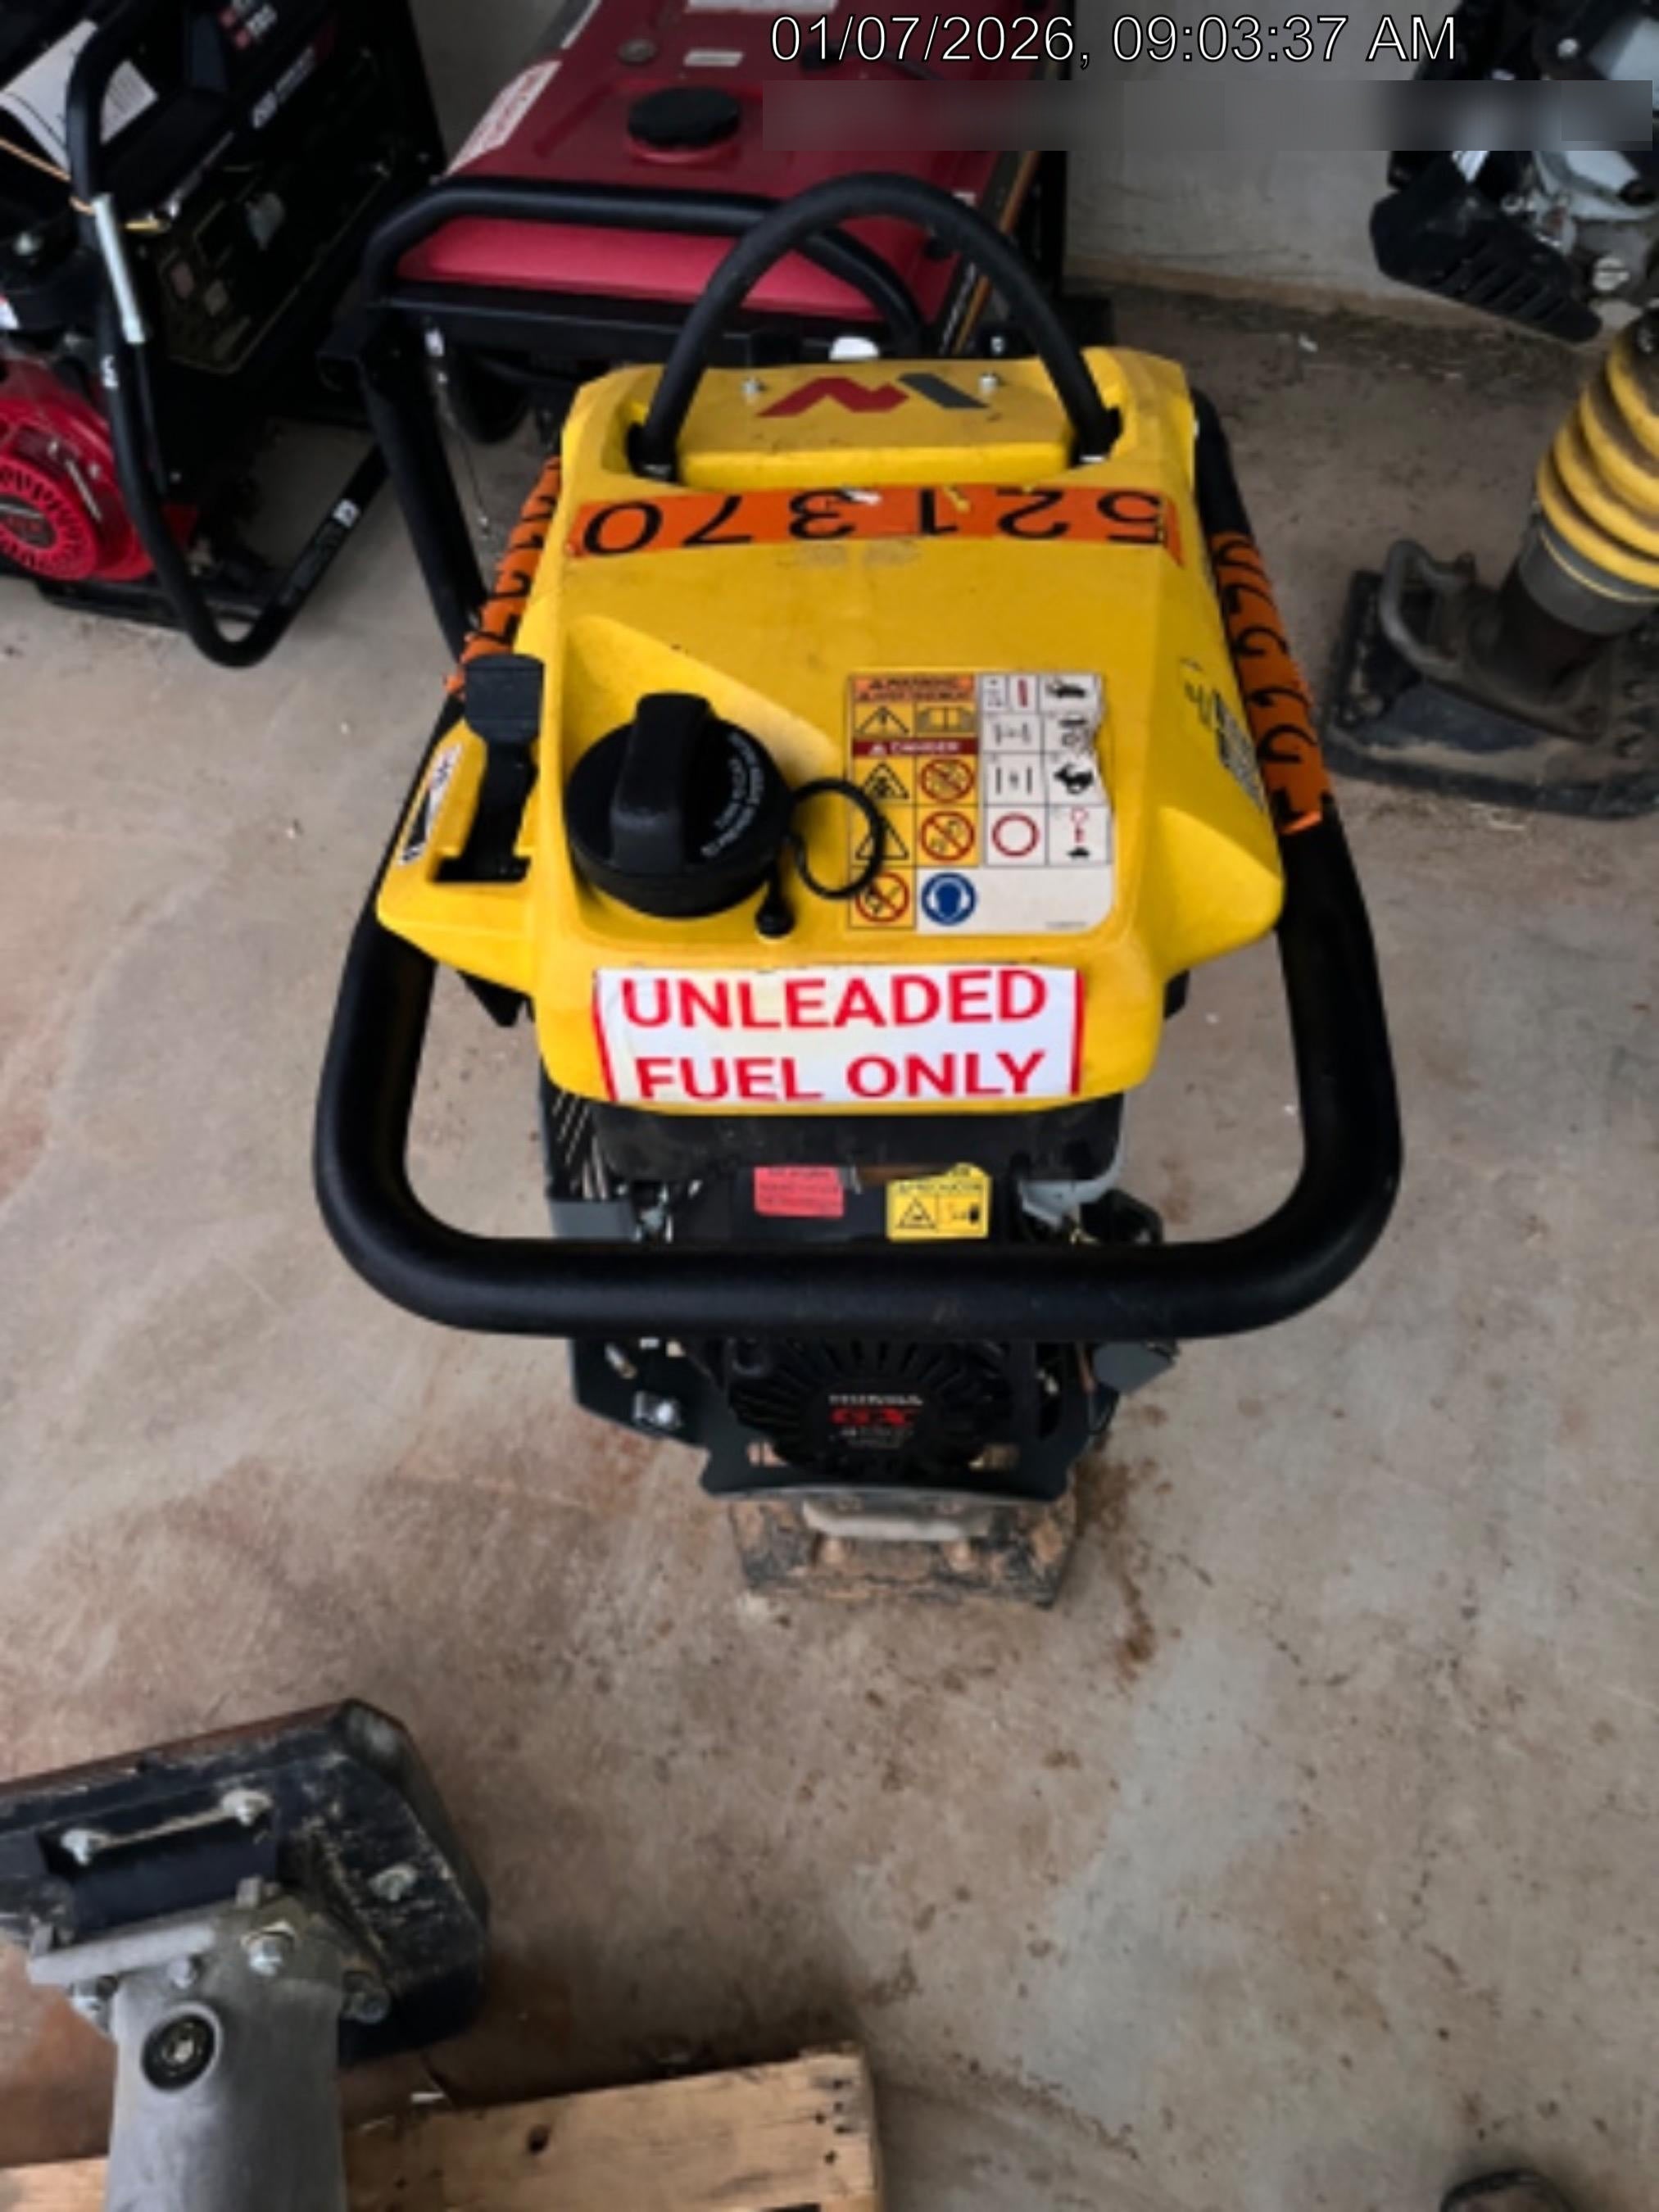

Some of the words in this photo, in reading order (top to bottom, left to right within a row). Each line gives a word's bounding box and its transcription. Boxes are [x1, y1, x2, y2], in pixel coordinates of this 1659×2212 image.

[582, 488, 1167, 555] 521370
[620, 968, 1047, 1029] UNLEADED
[634, 1056, 824, 1102] FUEL
[846, 1050, 1045, 1098] ONLY
